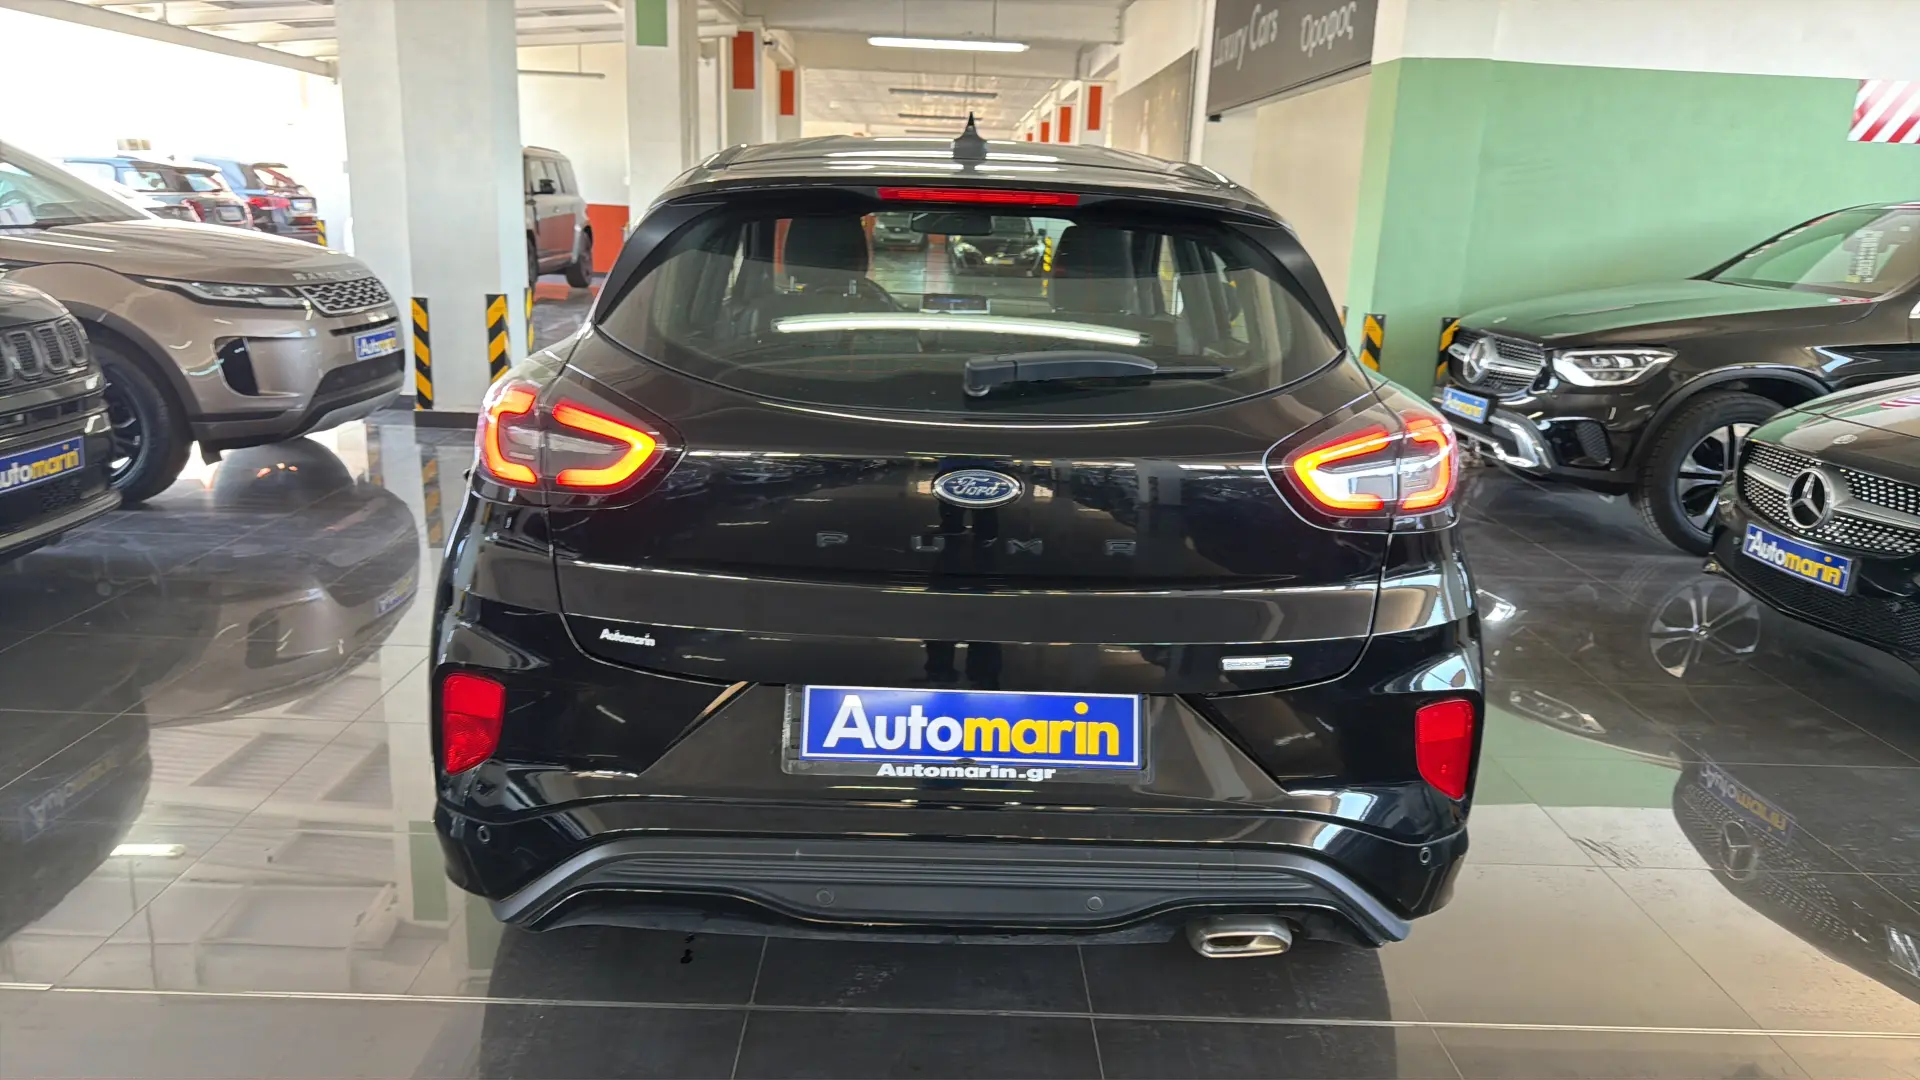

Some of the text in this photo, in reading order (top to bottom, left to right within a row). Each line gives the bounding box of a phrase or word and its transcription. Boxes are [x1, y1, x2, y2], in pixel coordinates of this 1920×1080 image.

[1213, 3, 1278, 71] Luxury Cars
[0, 443, 79, 489] utomarin
[953, 476, 1002, 497] Ford
[816, 531, 1137, 556] PUMA
[1748, 531, 1842, 585] Automarin
[599, 628, 656, 647] Automarin
[822, 694, 1120, 757] Automarin
[876, 763, 1057, 782] Automarin.gr
